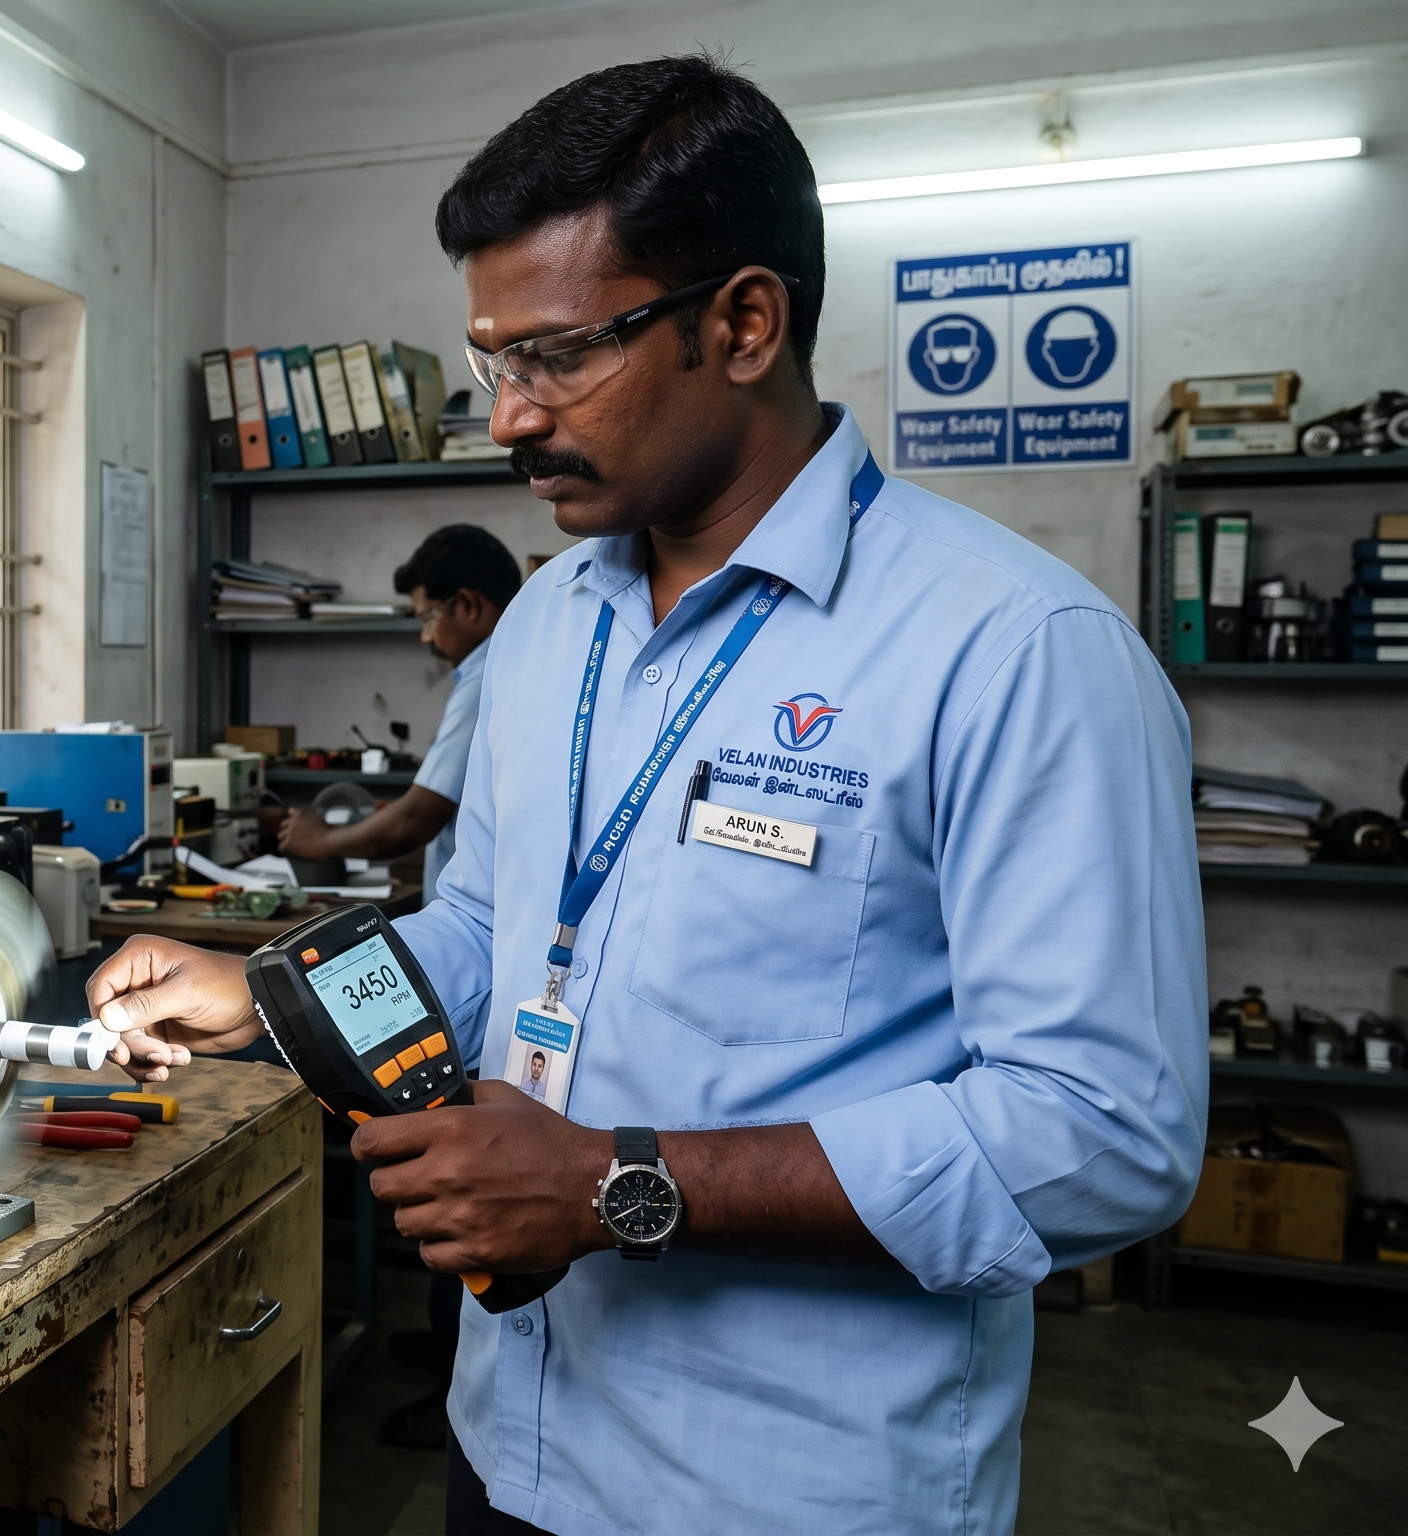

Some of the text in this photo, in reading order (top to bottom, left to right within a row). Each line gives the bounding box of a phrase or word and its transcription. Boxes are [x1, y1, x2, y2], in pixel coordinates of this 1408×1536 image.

[900, 414, 1003, 437] Wear Safety
[1017, 408, 1125, 432] Wear Safety
[906, 439, 996, 463] Equipment
[1024, 434, 1118, 459] Equipment
[718, 747, 869, 789] VELAN INDUSTRIES
[725, 815, 784, 840] ARUN S.
[341, 964, 398, 1010] 3450
